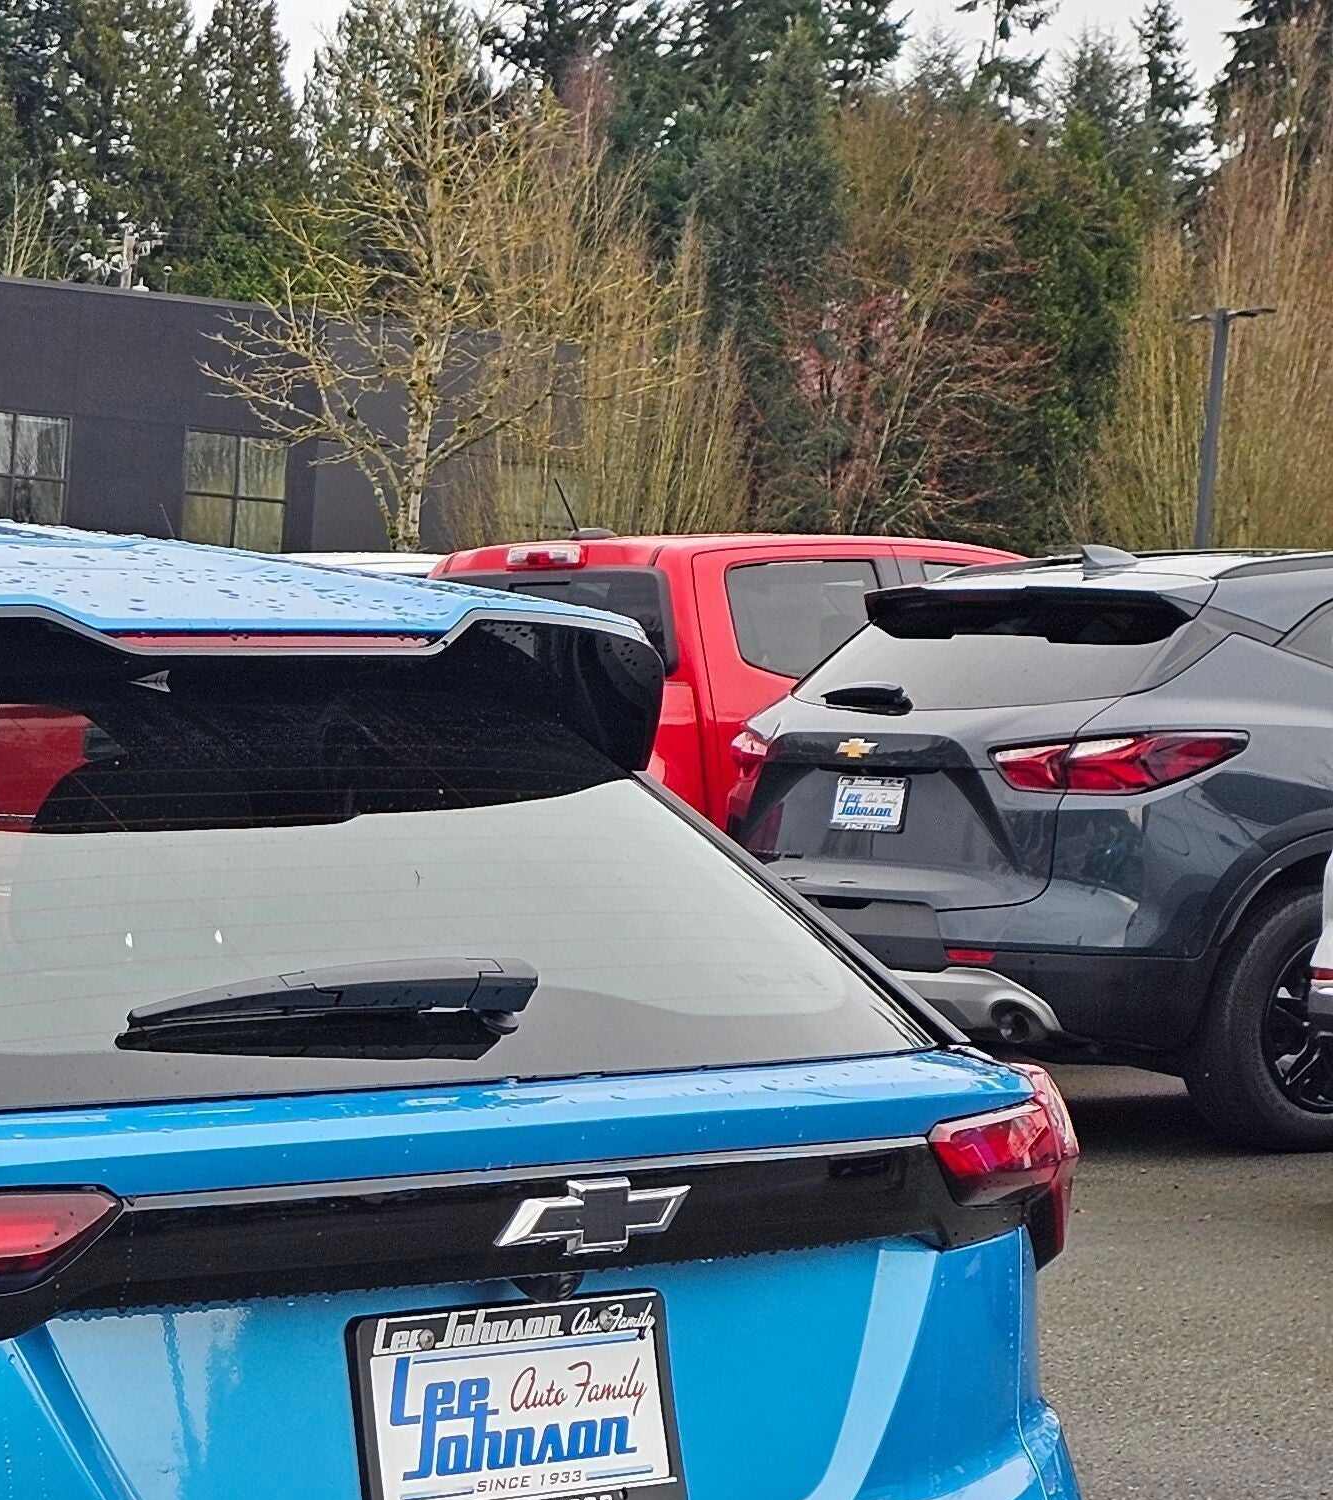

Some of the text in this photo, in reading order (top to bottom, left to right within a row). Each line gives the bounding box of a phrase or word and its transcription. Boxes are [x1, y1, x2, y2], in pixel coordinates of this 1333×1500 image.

[435, 1309, 564, 1349] Johnson
[390, 1356, 648, 1426] Lee Auto Family
[402, 1403, 637, 1482] Johnson
[476, 1470, 582, 1493] SINCE 1933
